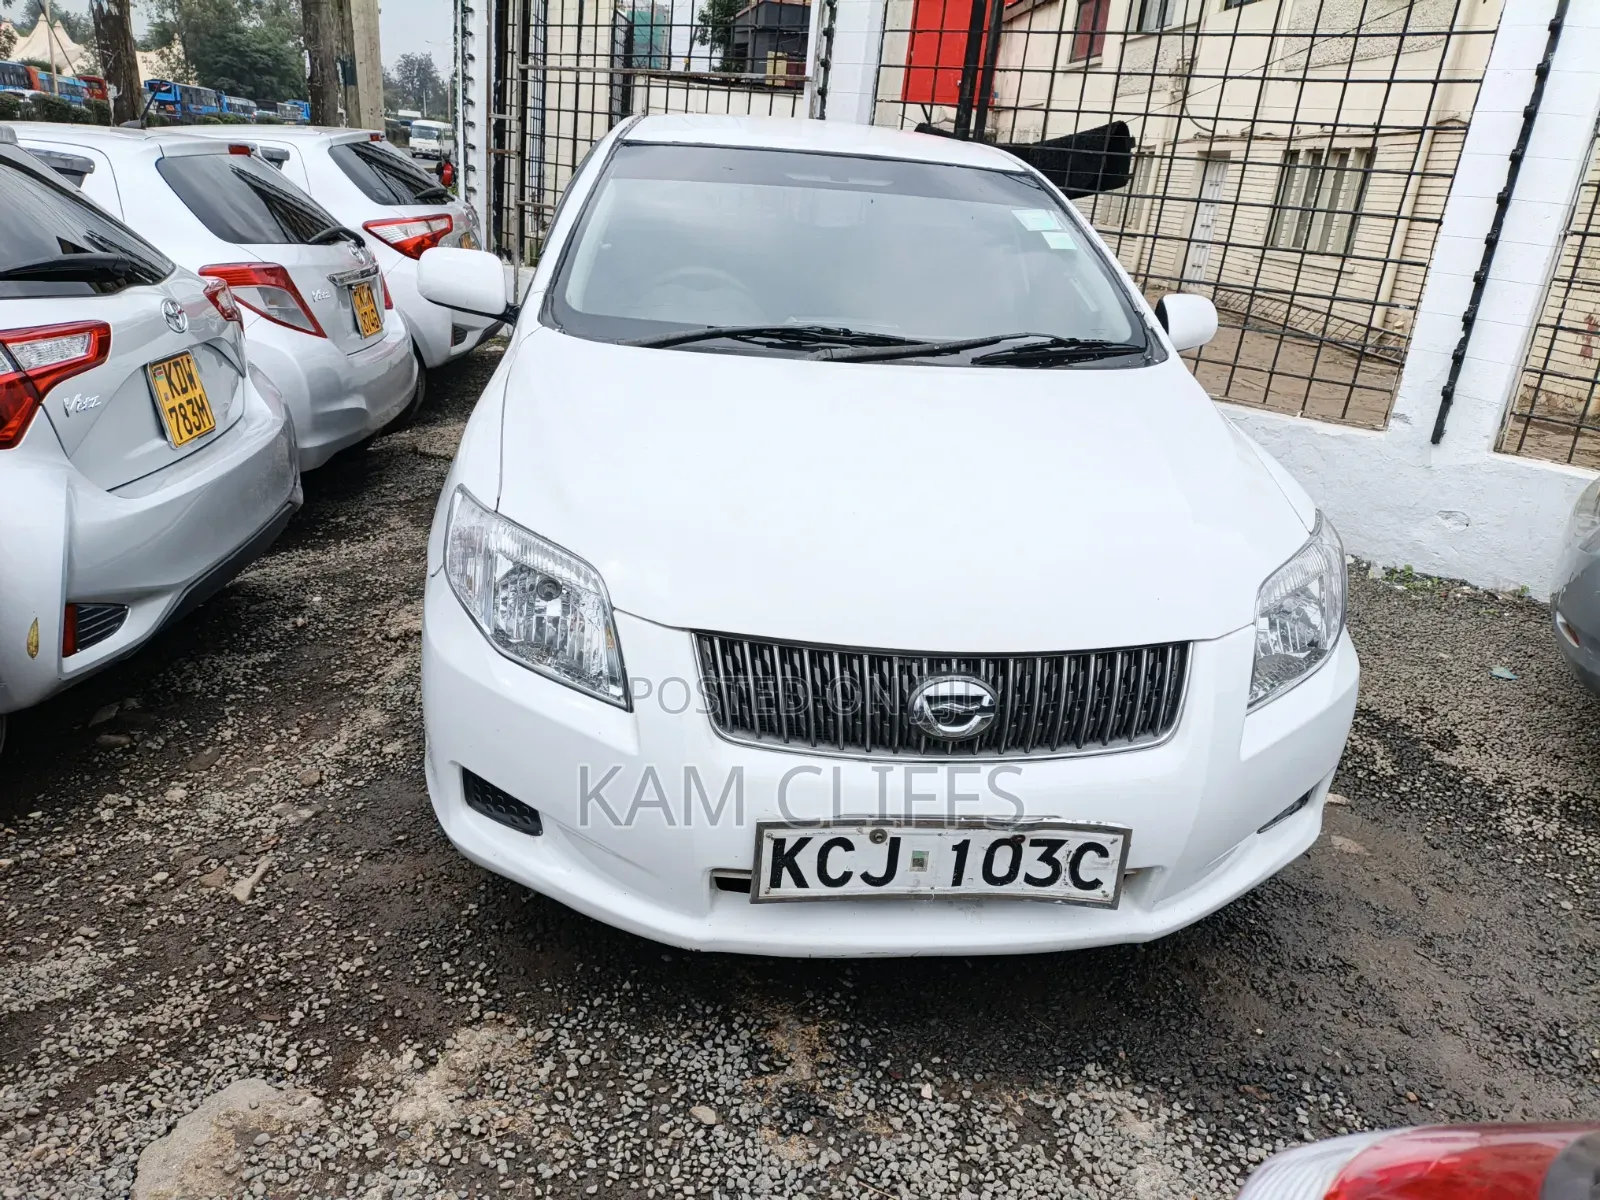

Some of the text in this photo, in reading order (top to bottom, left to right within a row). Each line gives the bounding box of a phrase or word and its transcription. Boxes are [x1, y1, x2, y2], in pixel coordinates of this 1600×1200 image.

[162, 357, 198, 399] KDW
[63, 393, 102, 418] Vitz
[168, 393, 212, 441] 783M
[769, 836, 1110, 892] KCJ 103C
